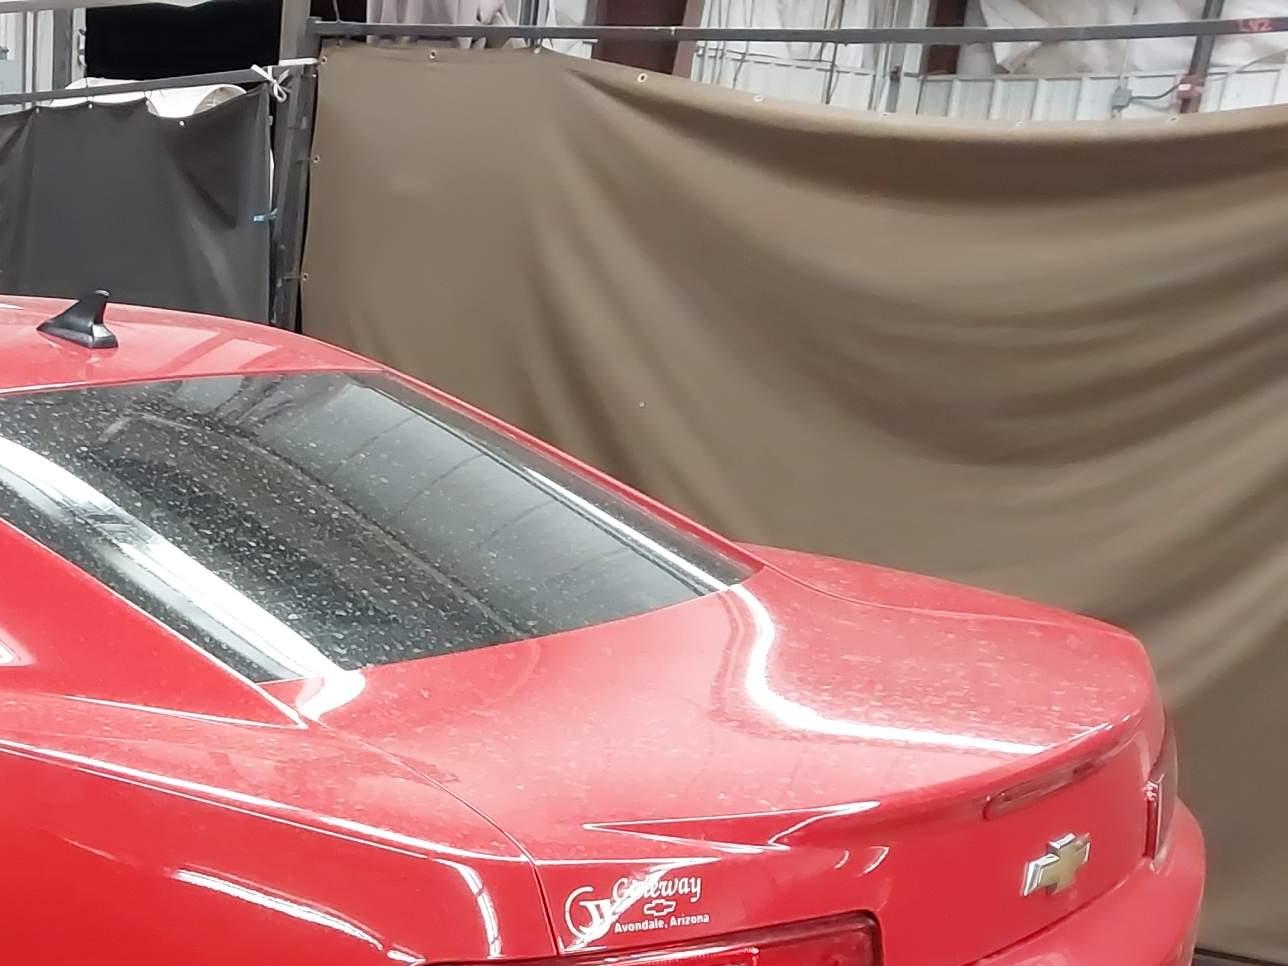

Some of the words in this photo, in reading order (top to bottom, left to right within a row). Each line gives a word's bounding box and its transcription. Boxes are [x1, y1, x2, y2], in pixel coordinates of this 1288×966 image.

[612, 876, 702, 903] Geway
[614, 918, 669, 934] Avondale,
[670, 914, 710, 927] Arizona
